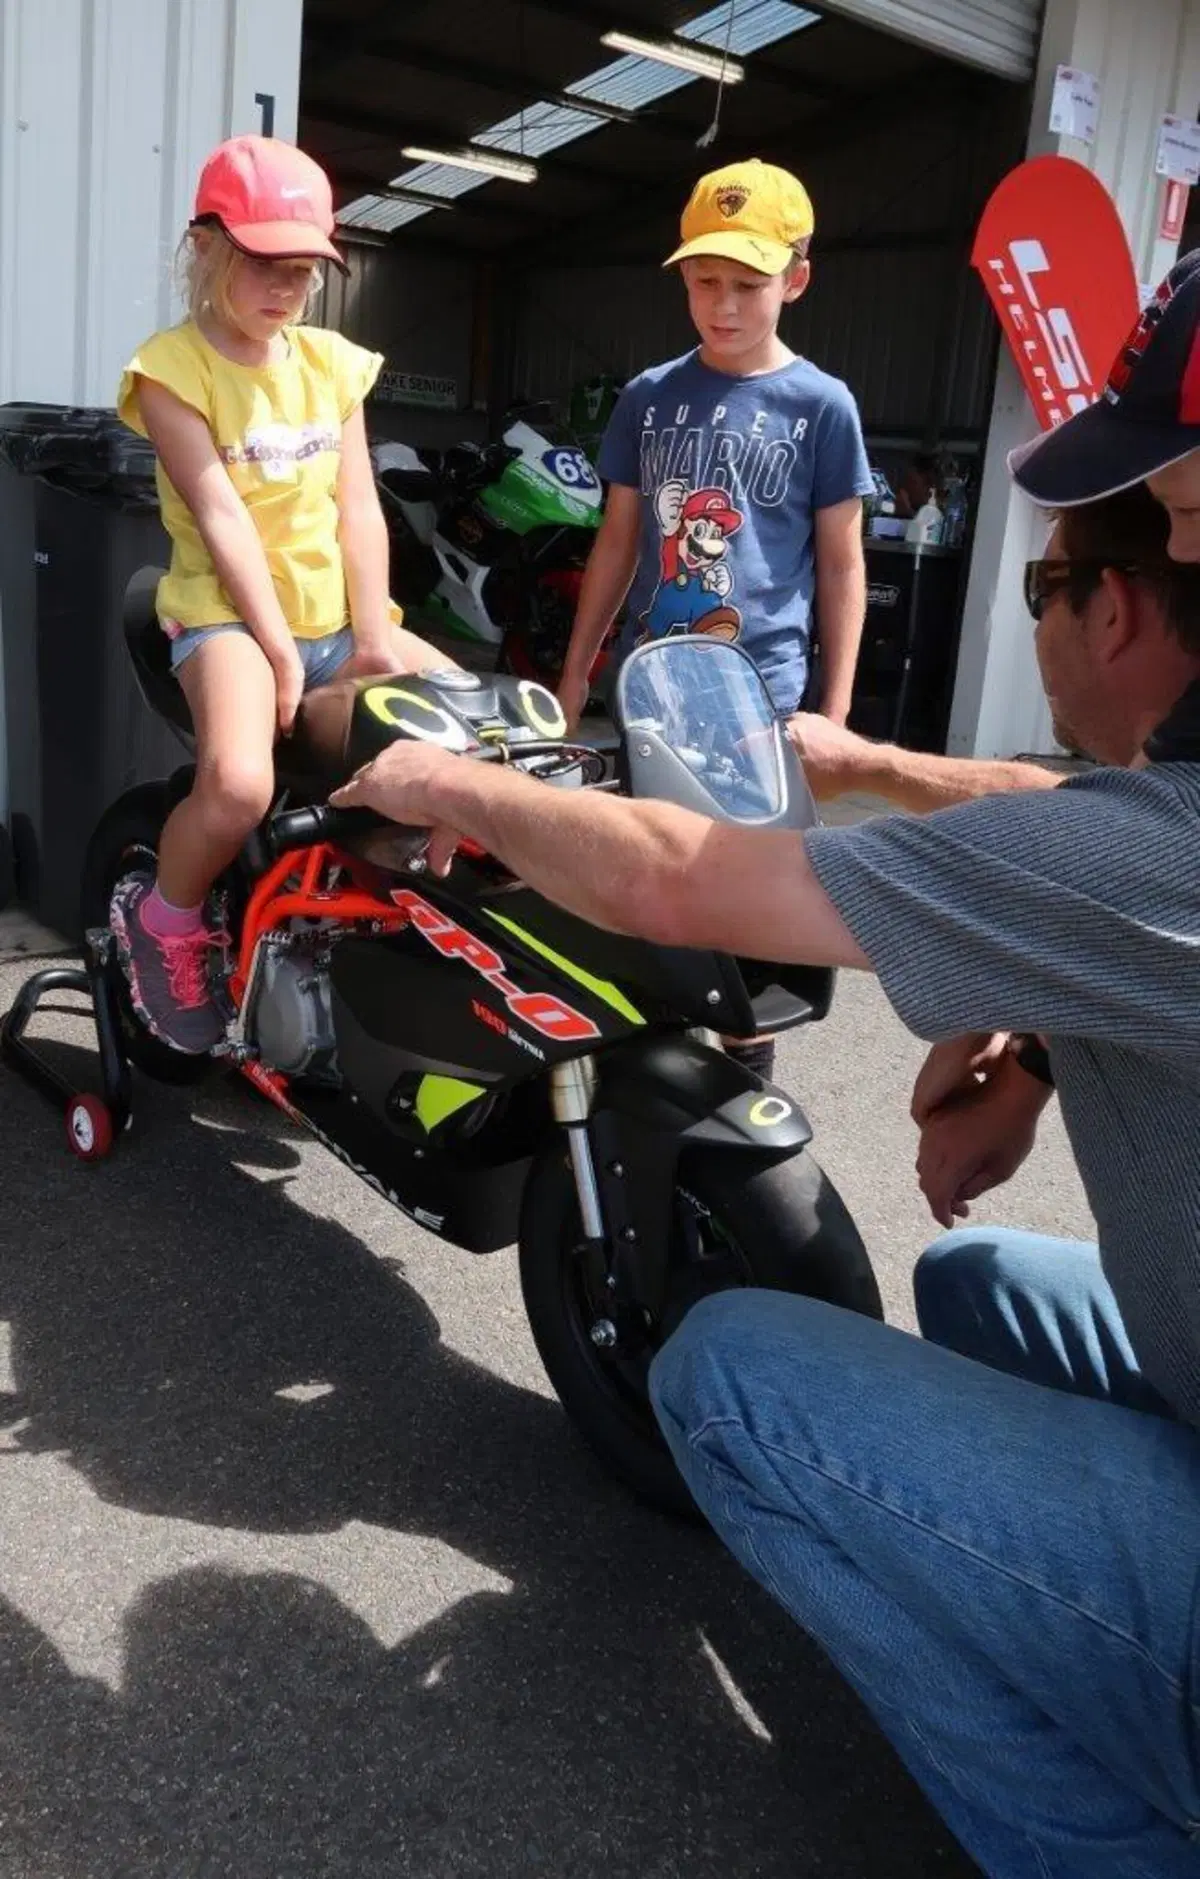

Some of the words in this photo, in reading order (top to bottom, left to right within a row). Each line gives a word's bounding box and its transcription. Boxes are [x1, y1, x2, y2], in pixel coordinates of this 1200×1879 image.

[643, 404, 808, 442] SUPER
[555, 452, 595, 485] 68
[640, 428, 798, 508] MARIO
